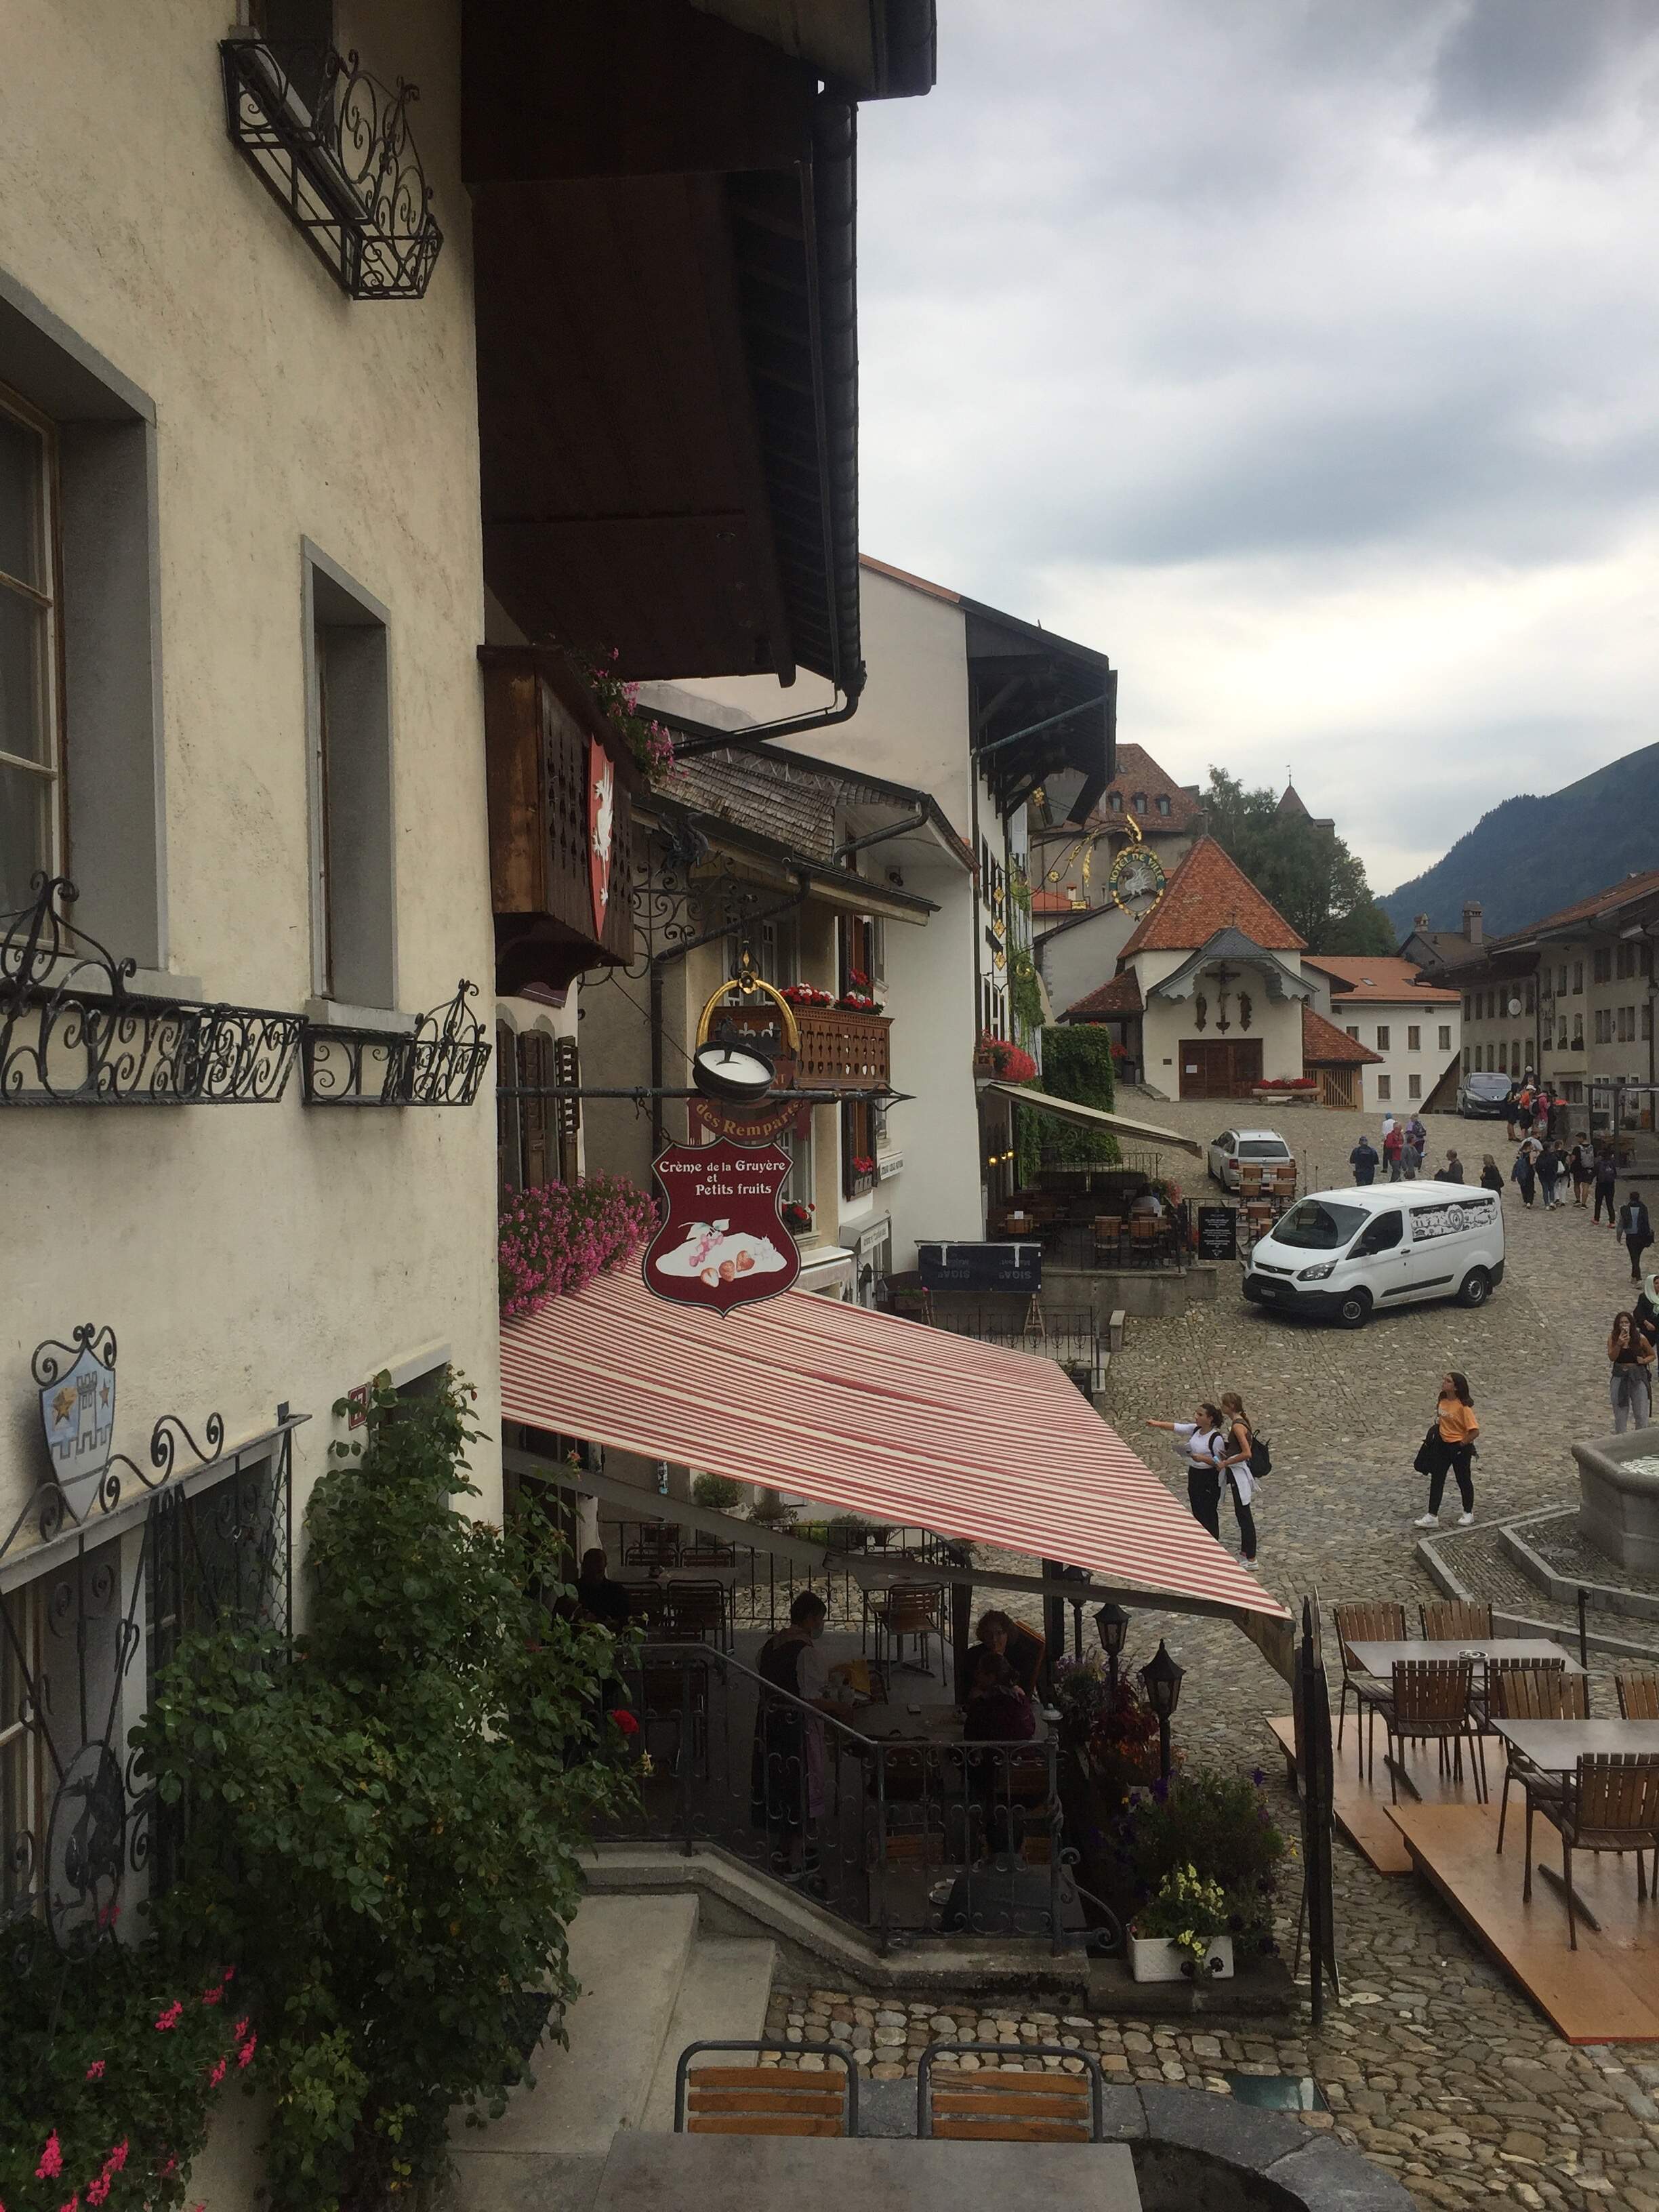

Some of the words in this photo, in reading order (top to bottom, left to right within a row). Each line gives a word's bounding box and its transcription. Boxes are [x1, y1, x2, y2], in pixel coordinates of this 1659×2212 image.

[1132, 853, 1147, 861] DE
[1148, 858, 1164, 882] VILLE
[697, 1103, 720, 1128] des
[659, 1161, 702, 1174] Crème
[706, 1162, 720, 1172] de
[722, 1162, 731, 1172] la
[735, 1160, 786, 1174] Gruyère
[707, 1174, 717, 1183] et
[695, 1184, 733, 1195] Petits
[737, 1183, 772, 1194] fruits
